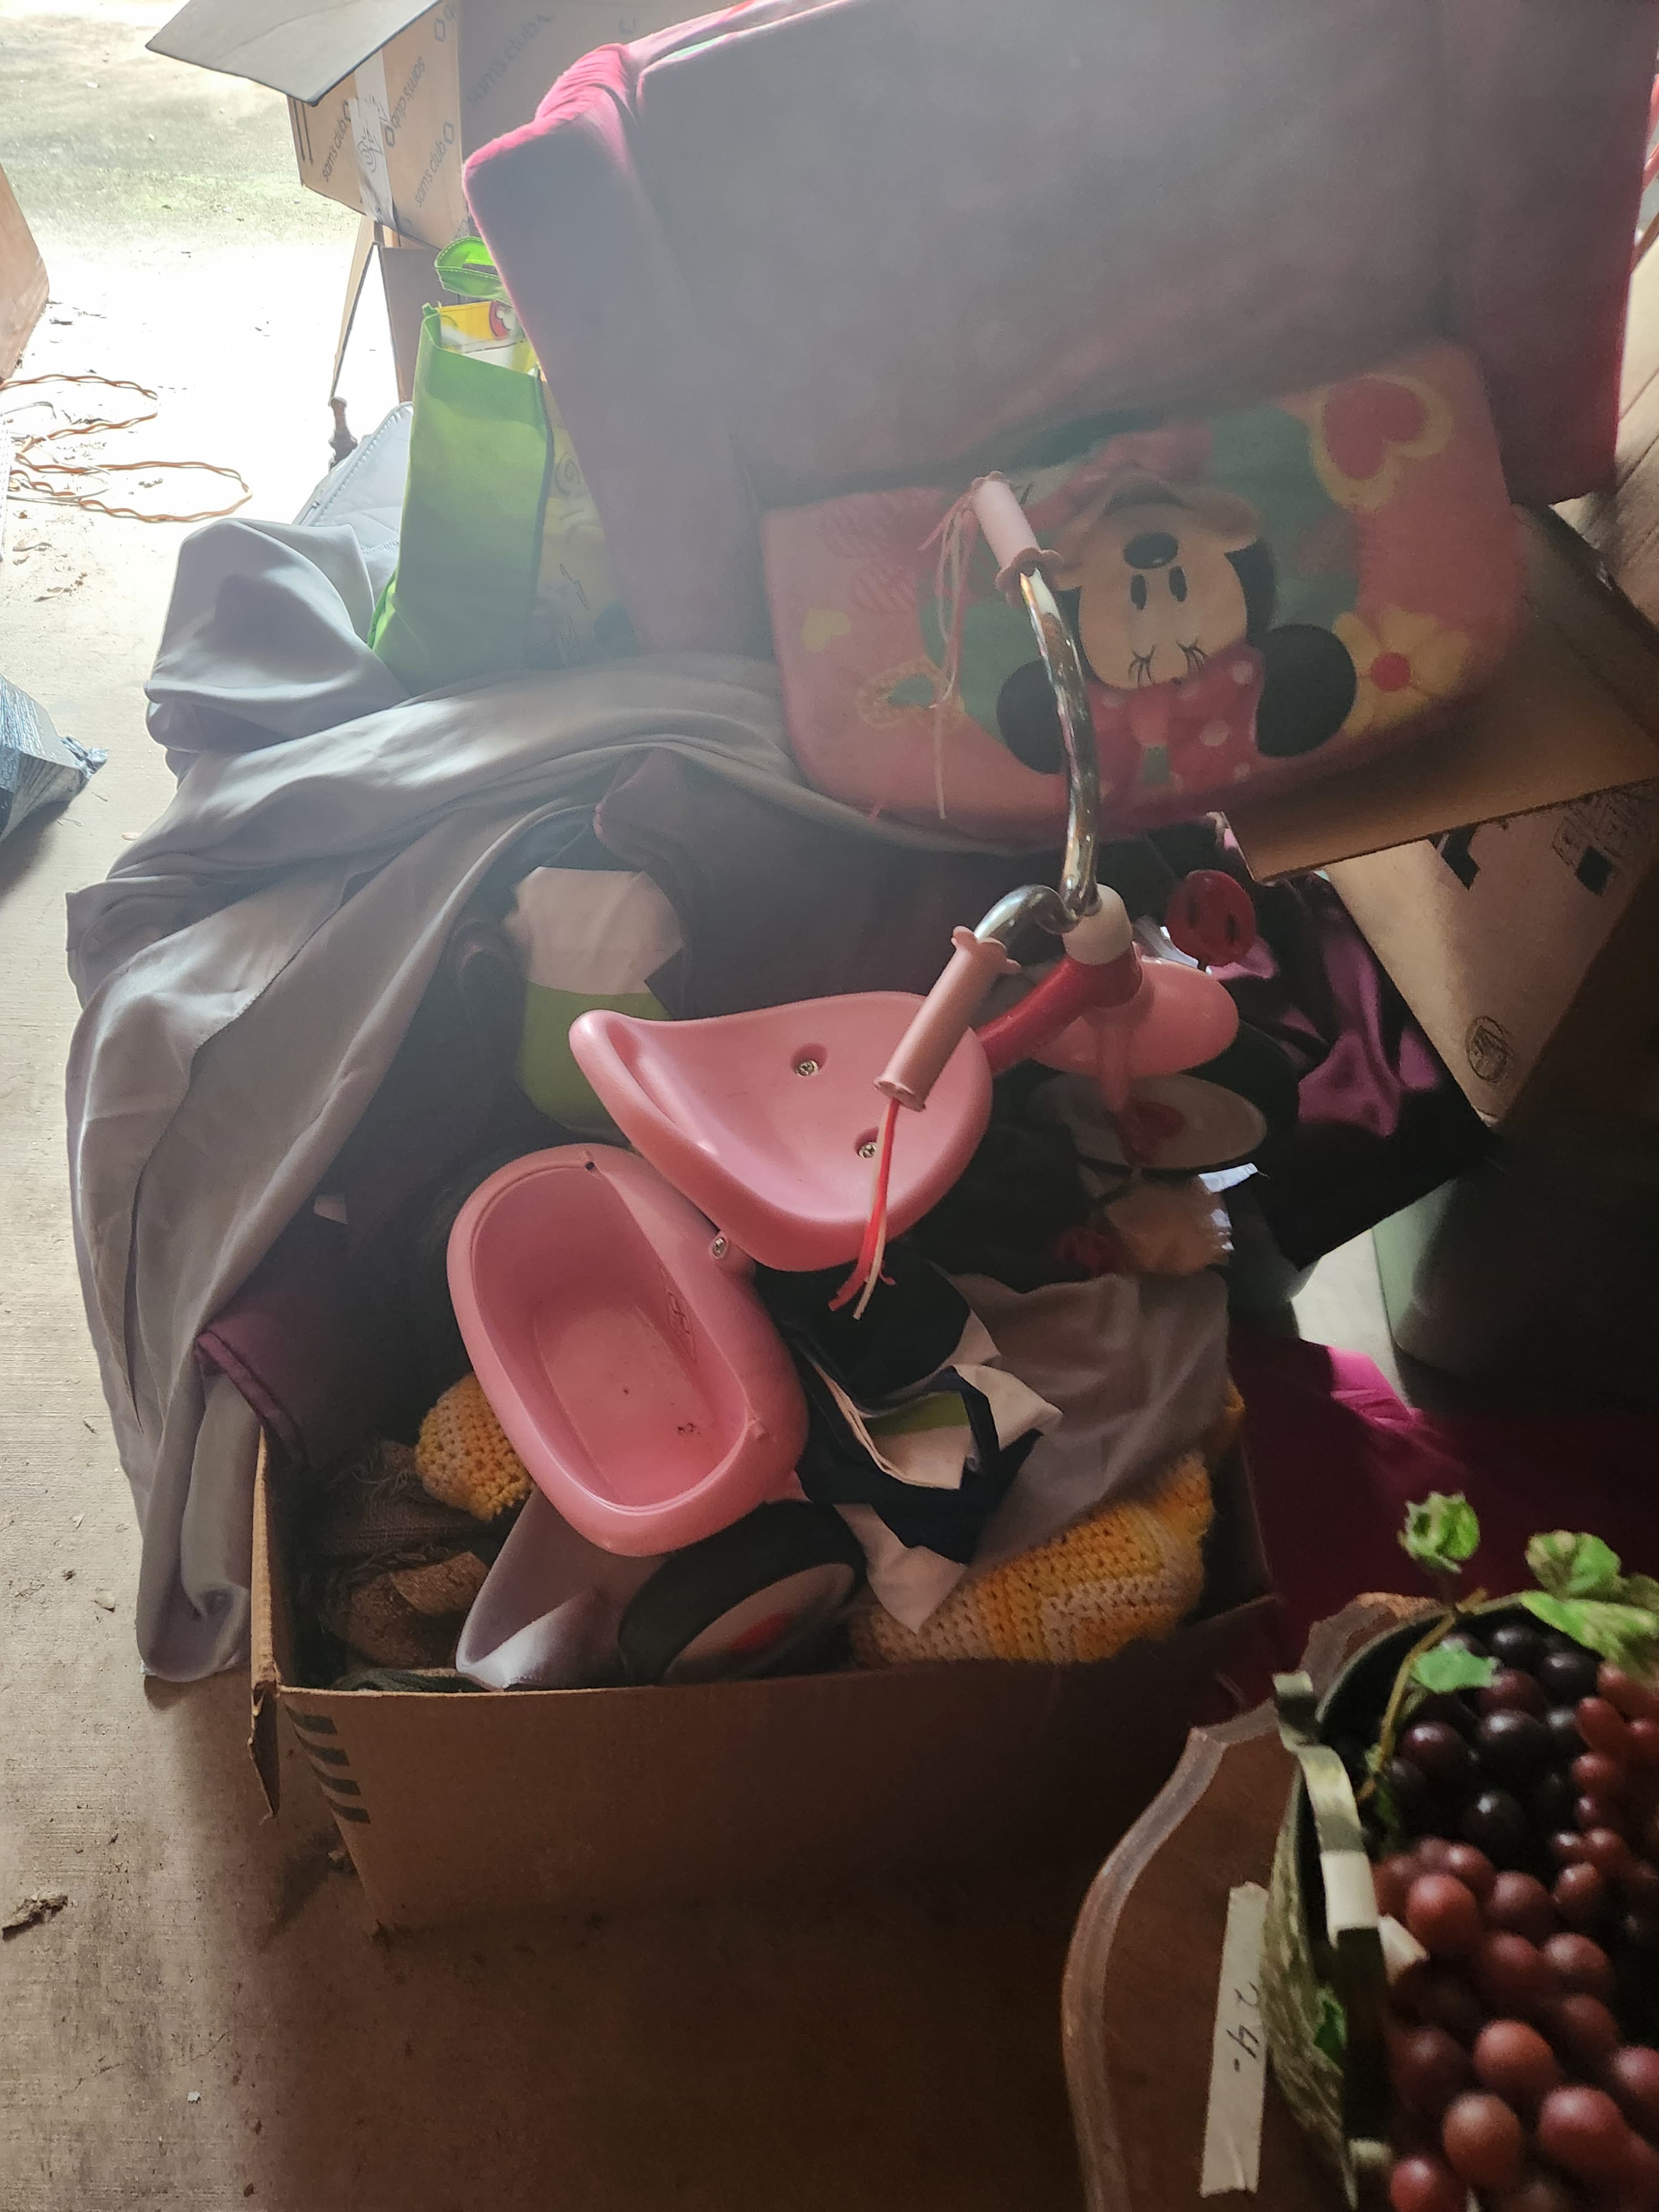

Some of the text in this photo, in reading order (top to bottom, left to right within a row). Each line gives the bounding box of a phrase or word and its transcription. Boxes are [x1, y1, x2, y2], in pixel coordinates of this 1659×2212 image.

[504, 21, 540, 60] club
[390, 96, 407, 129] club
[335, 117, 347, 149] club
[429, 140, 446, 174] club
